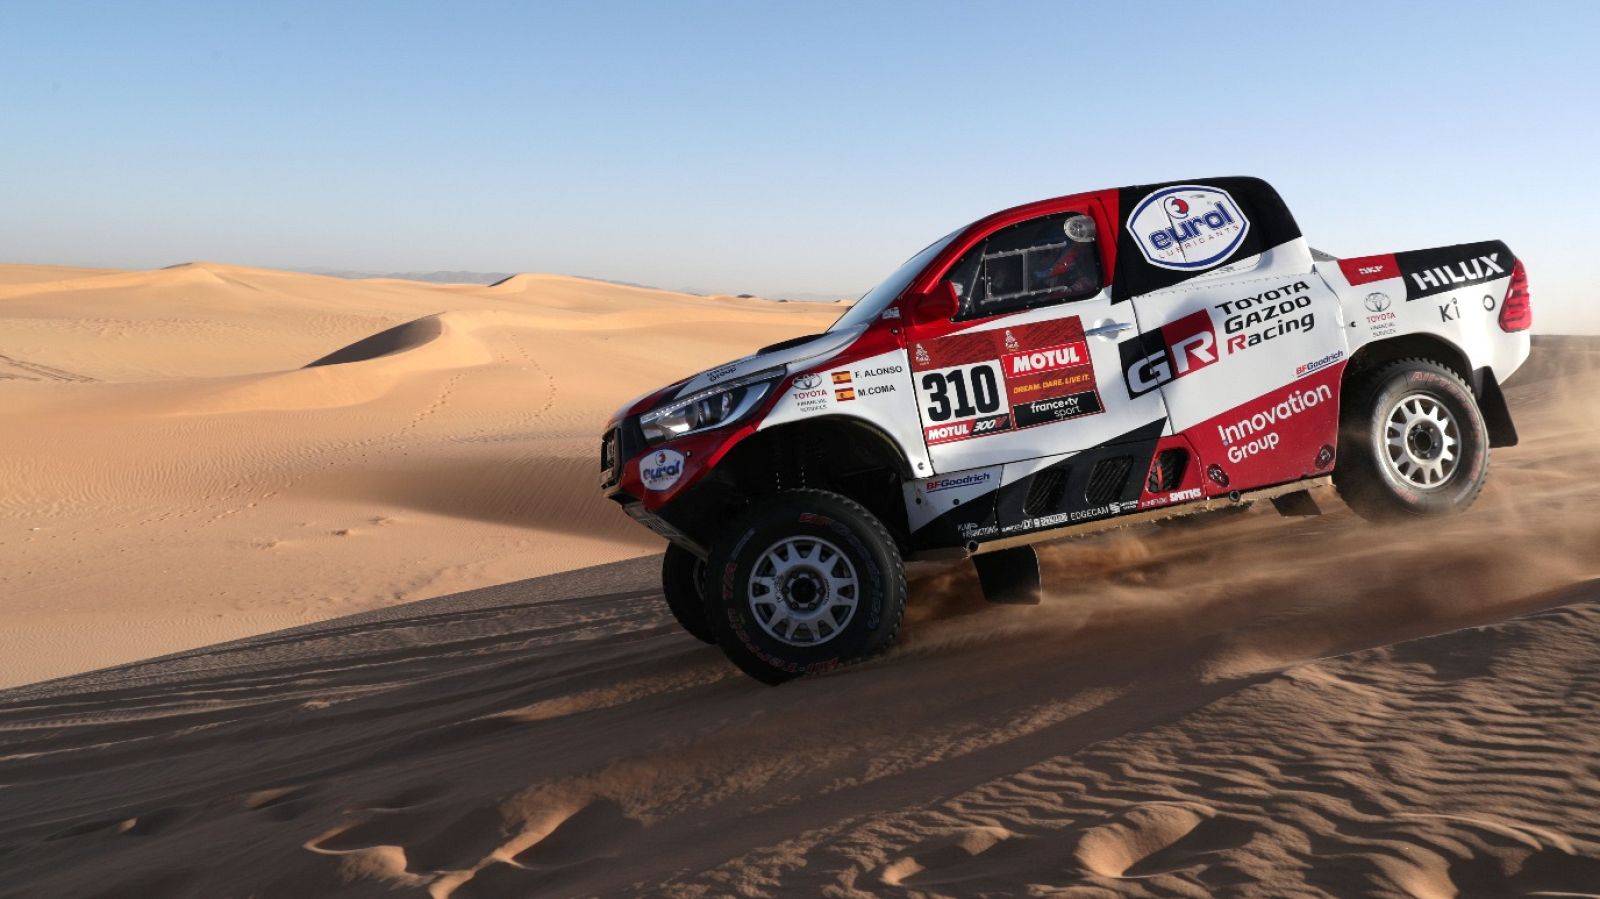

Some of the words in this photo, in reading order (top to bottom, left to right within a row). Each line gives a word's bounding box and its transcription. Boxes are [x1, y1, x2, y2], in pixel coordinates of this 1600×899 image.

[1149, 200, 1235, 250] eurol
[1159, 224, 1240, 259] LUBRICANTS
[1412, 252, 1505, 291] HILUX
[1214, 280, 1310, 317] TOYOTA
[1223, 295, 1312, 335] GAZOO
[1366, 312, 1396, 324] TOYOTA
[1227, 311, 1316, 355] Racing
[864, 365, 904, 378] ALONSO
[1013, 347, 1080, 374] MOTUL
[1126, 330, 1219, 393] GR
[1295, 349, 1344, 376] BFGoodrich
[921, 364, 1001, 422] 310
[1065, 375, 1082, 385] LIVE
[793, 389, 828, 400] TOYOTA
[1054, 405, 1083, 421] sport
[1217, 383, 1332, 443] Innovation
[928, 424, 969, 441] MOTUL
[1227, 430, 1281, 465] Group
[643, 460, 681, 480] eurol
[926, 471, 991, 493] BFGoodrich
[1070, 505, 1110, 521] EDGECAM
